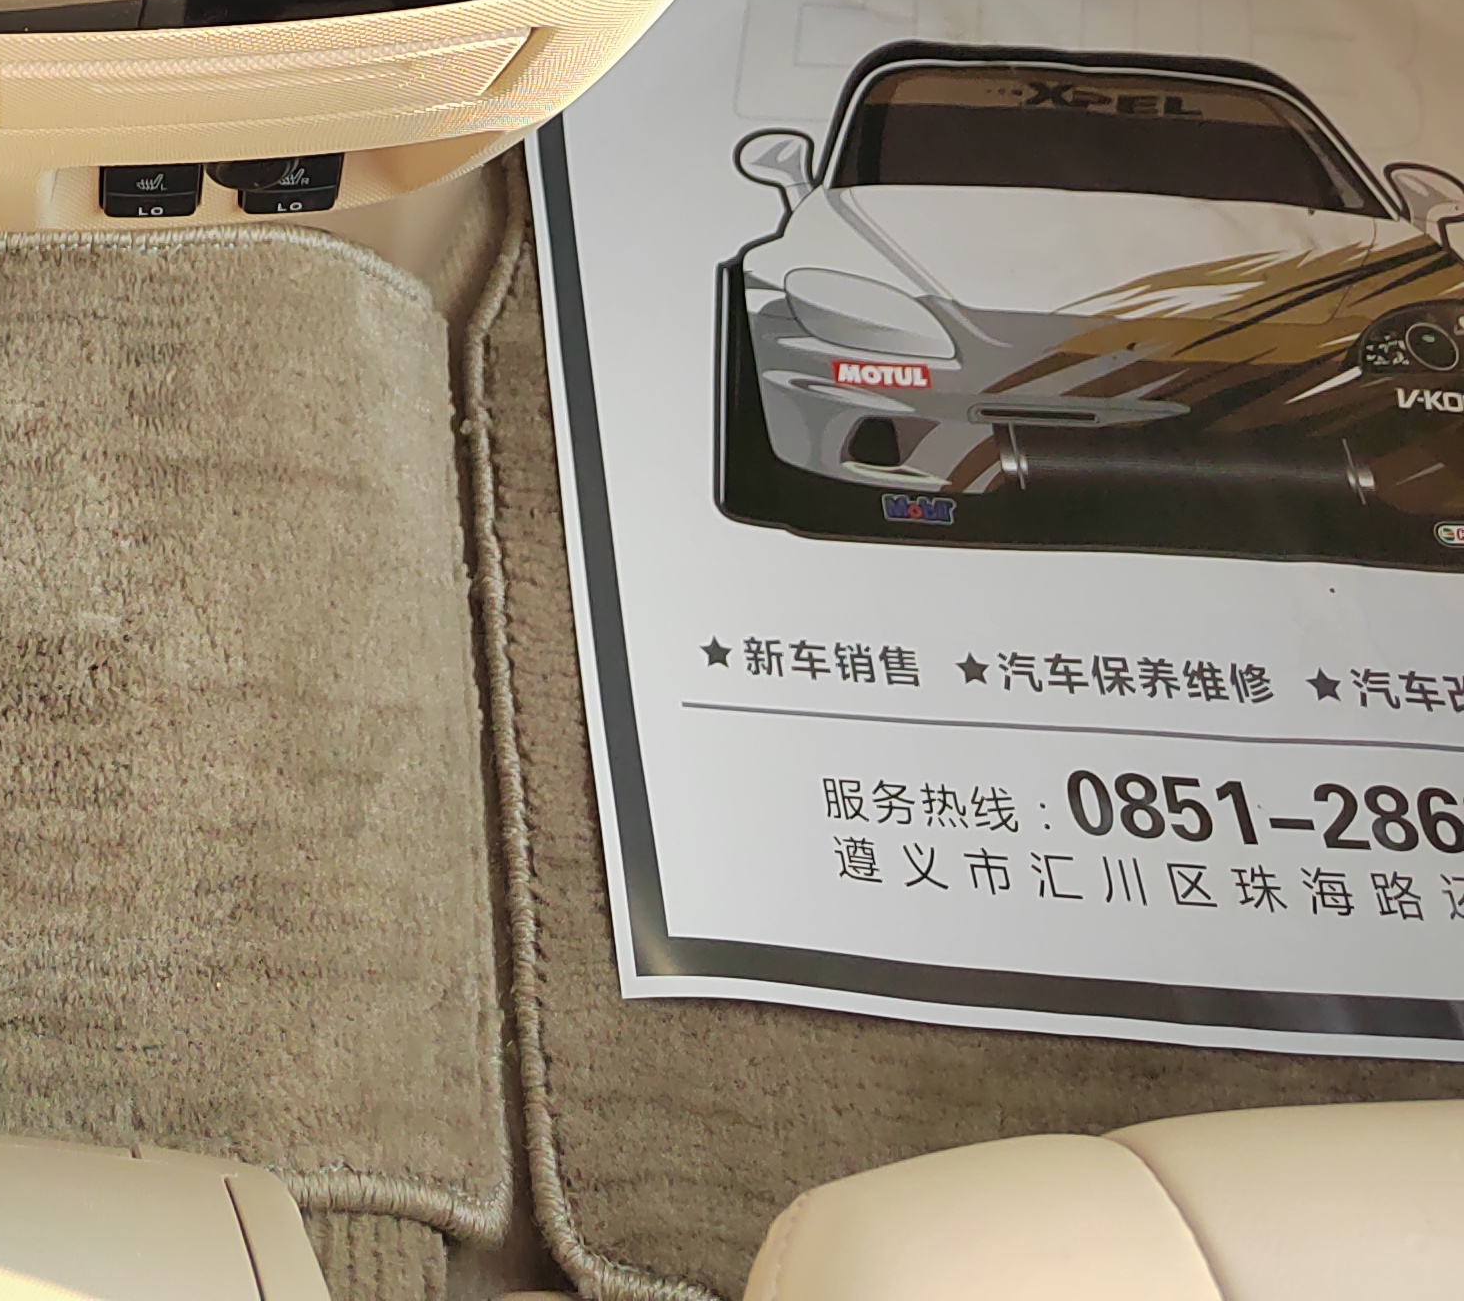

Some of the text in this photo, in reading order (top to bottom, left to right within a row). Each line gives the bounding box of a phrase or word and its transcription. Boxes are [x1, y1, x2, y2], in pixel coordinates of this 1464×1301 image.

[138, 205, 165, 217] LO
[276, 200, 303, 213] LO
[837, 362, 928, 387] MOTUL
[743, 636, 920, 687] 新车销售
[997, 652, 1274, 704] 汽车保养维修
